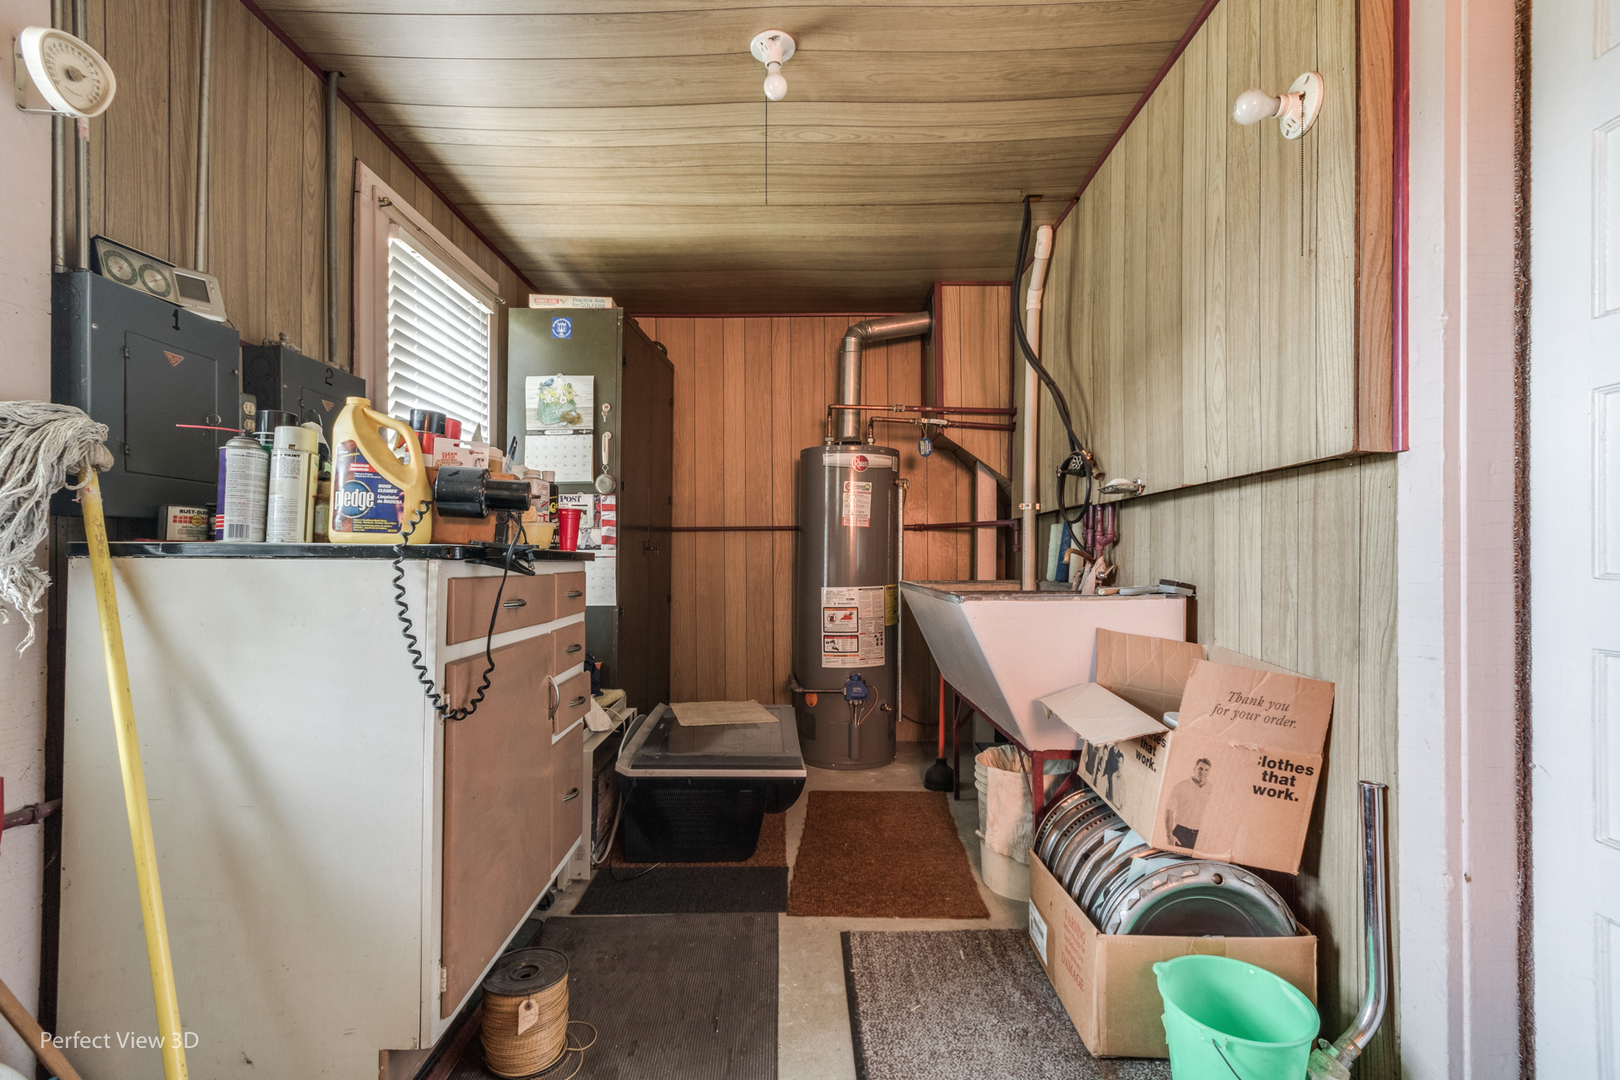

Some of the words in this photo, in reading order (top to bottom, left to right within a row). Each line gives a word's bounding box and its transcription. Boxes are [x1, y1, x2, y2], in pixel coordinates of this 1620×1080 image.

[172, 309, 181, 331] 1
[325, 367, 334, 386] 2
[334, 488, 375, 511] pledge
[1228, 691, 1265, 707] Thank
[1265, 700, 1291, 712] you
[1209, 703, 1230, 717] for
[1230, 708, 1261, 721] your
[1263, 715, 1297, 728] order.
[1140, 738, 1157, 757] that
[1135, 749, 1157, 773] work.
[1261, 770, 1297, 787] that
[1252, 785, 1299, 802] work.
[1061, 951, 1084, 992] DAMAGE
